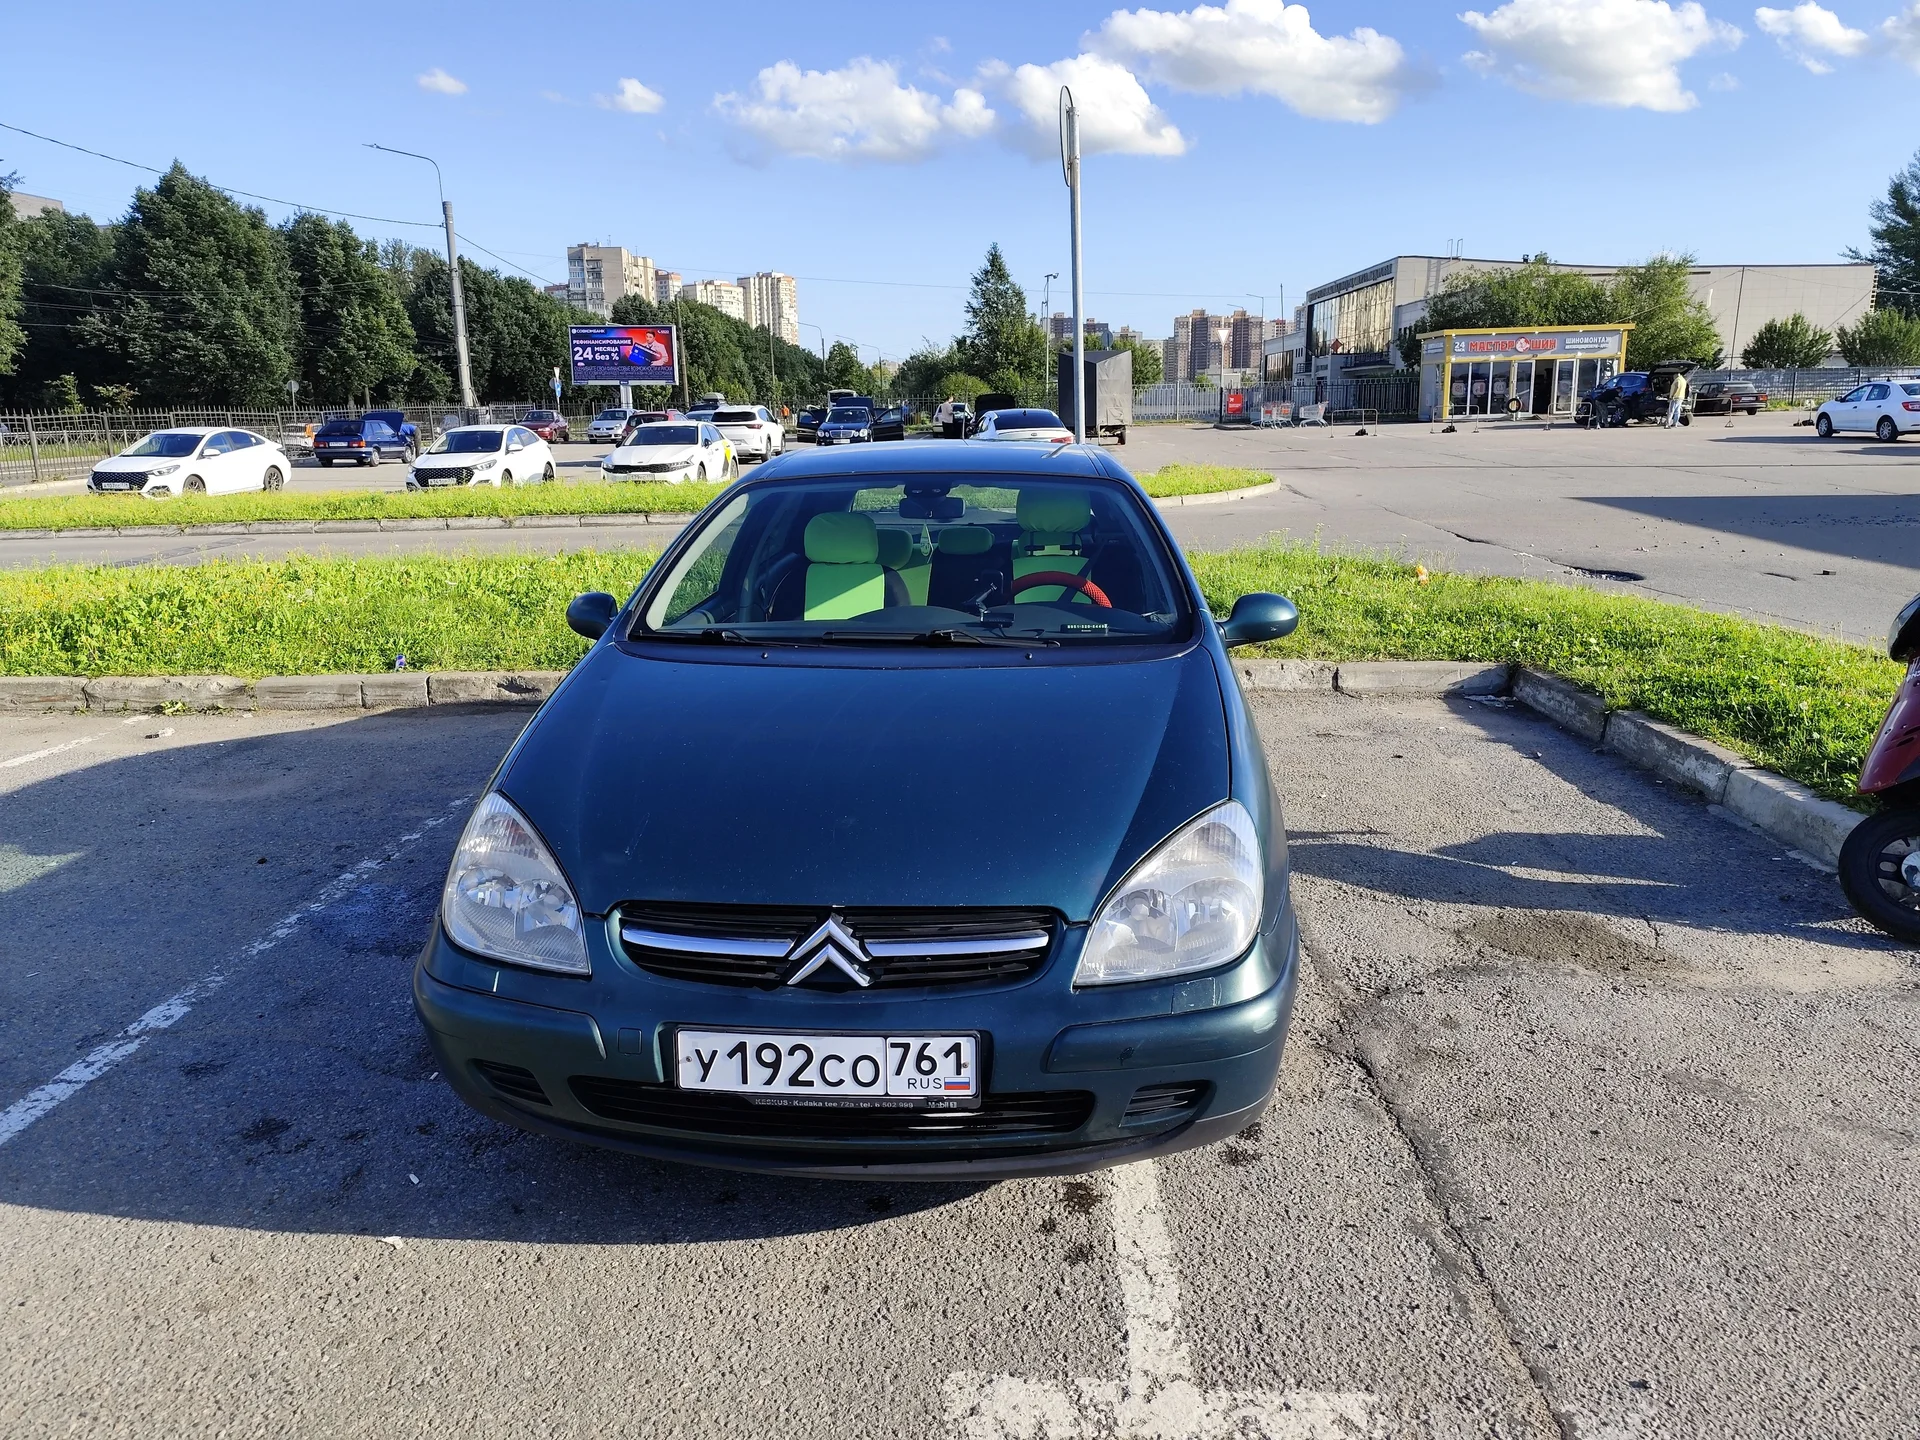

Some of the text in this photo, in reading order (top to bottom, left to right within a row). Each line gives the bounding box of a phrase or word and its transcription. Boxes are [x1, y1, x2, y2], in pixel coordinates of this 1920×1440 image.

[1454, 341, 1465, 349] 24
[1468, 340, 1516, 352] МАСТЕР
[1530, 338, 1557, 350] ШИН
[573, 346, 593, 361] 24
[694, 1041, 962, 1088] У192СО 761
[907, 1078, 942, 1090] RUS
